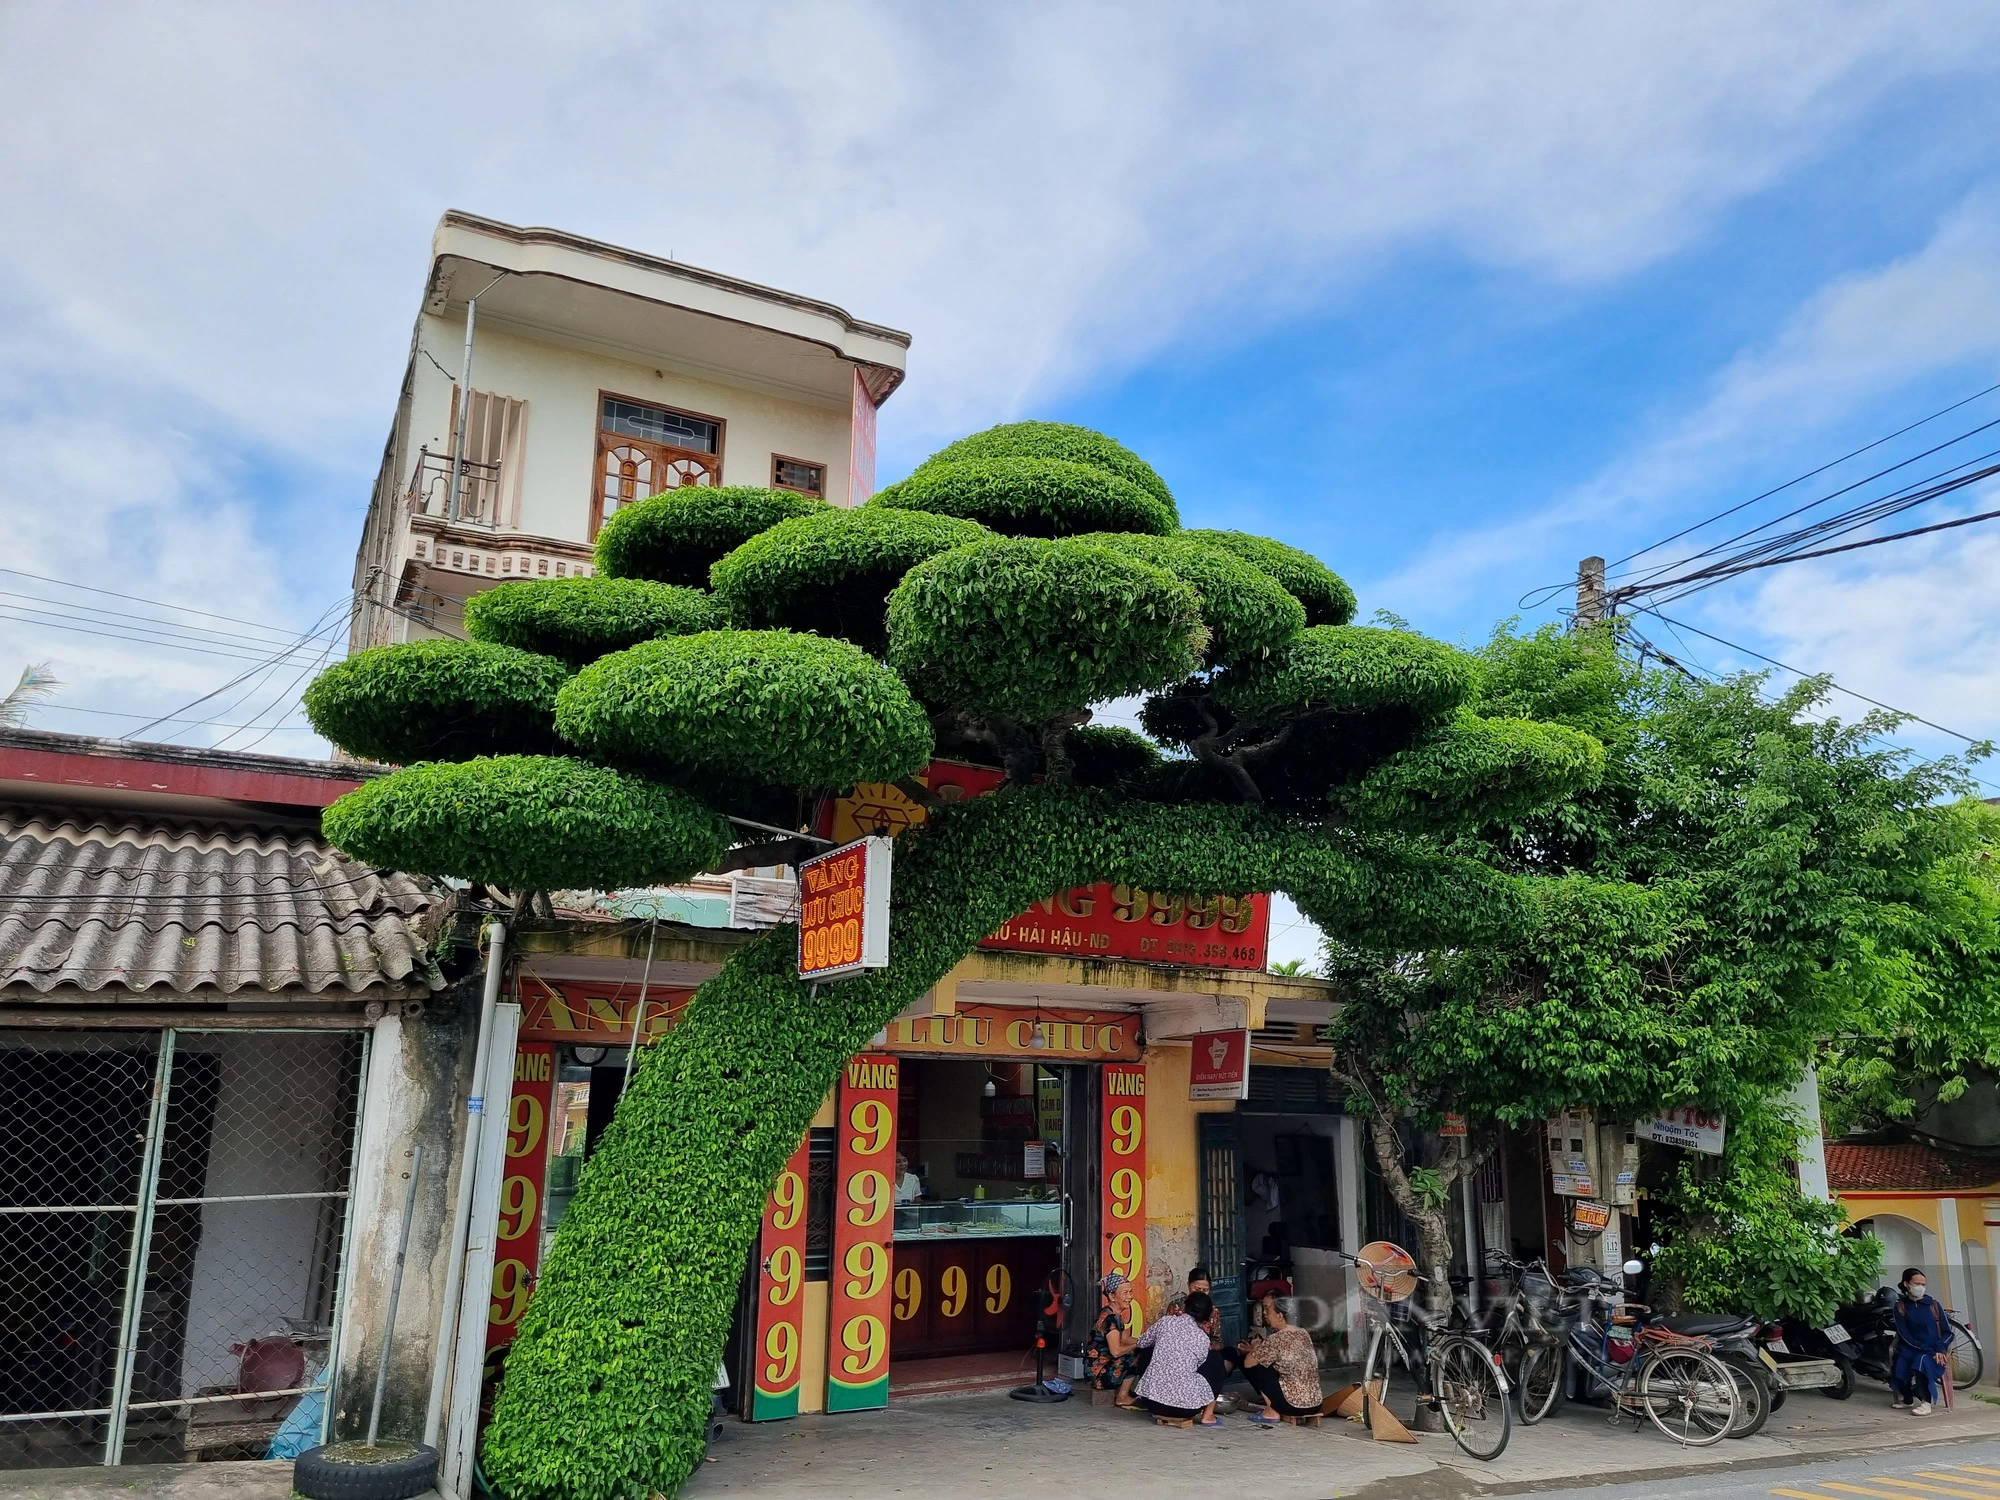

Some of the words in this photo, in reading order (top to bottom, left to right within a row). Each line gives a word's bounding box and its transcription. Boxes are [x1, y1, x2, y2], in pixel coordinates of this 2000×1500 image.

[806, 855, 860, 894] VÀNG
[802, 896, 827, 929] LƯU
[827, 880, 863, 921] CHÚC
[803, 918, 859, 971] 9999
[895, 1012, 994, 1047] LƯU
[1005, 1015, 1124, 1053] CHÚC
[513, 1046, 550, 1082] ÀNG
[848, 1060, 898, 1089] VÀNG
[1107, 1068, 1145, 1096] VÀNG
[1684, 1128, 1700, 1139] Tóc
